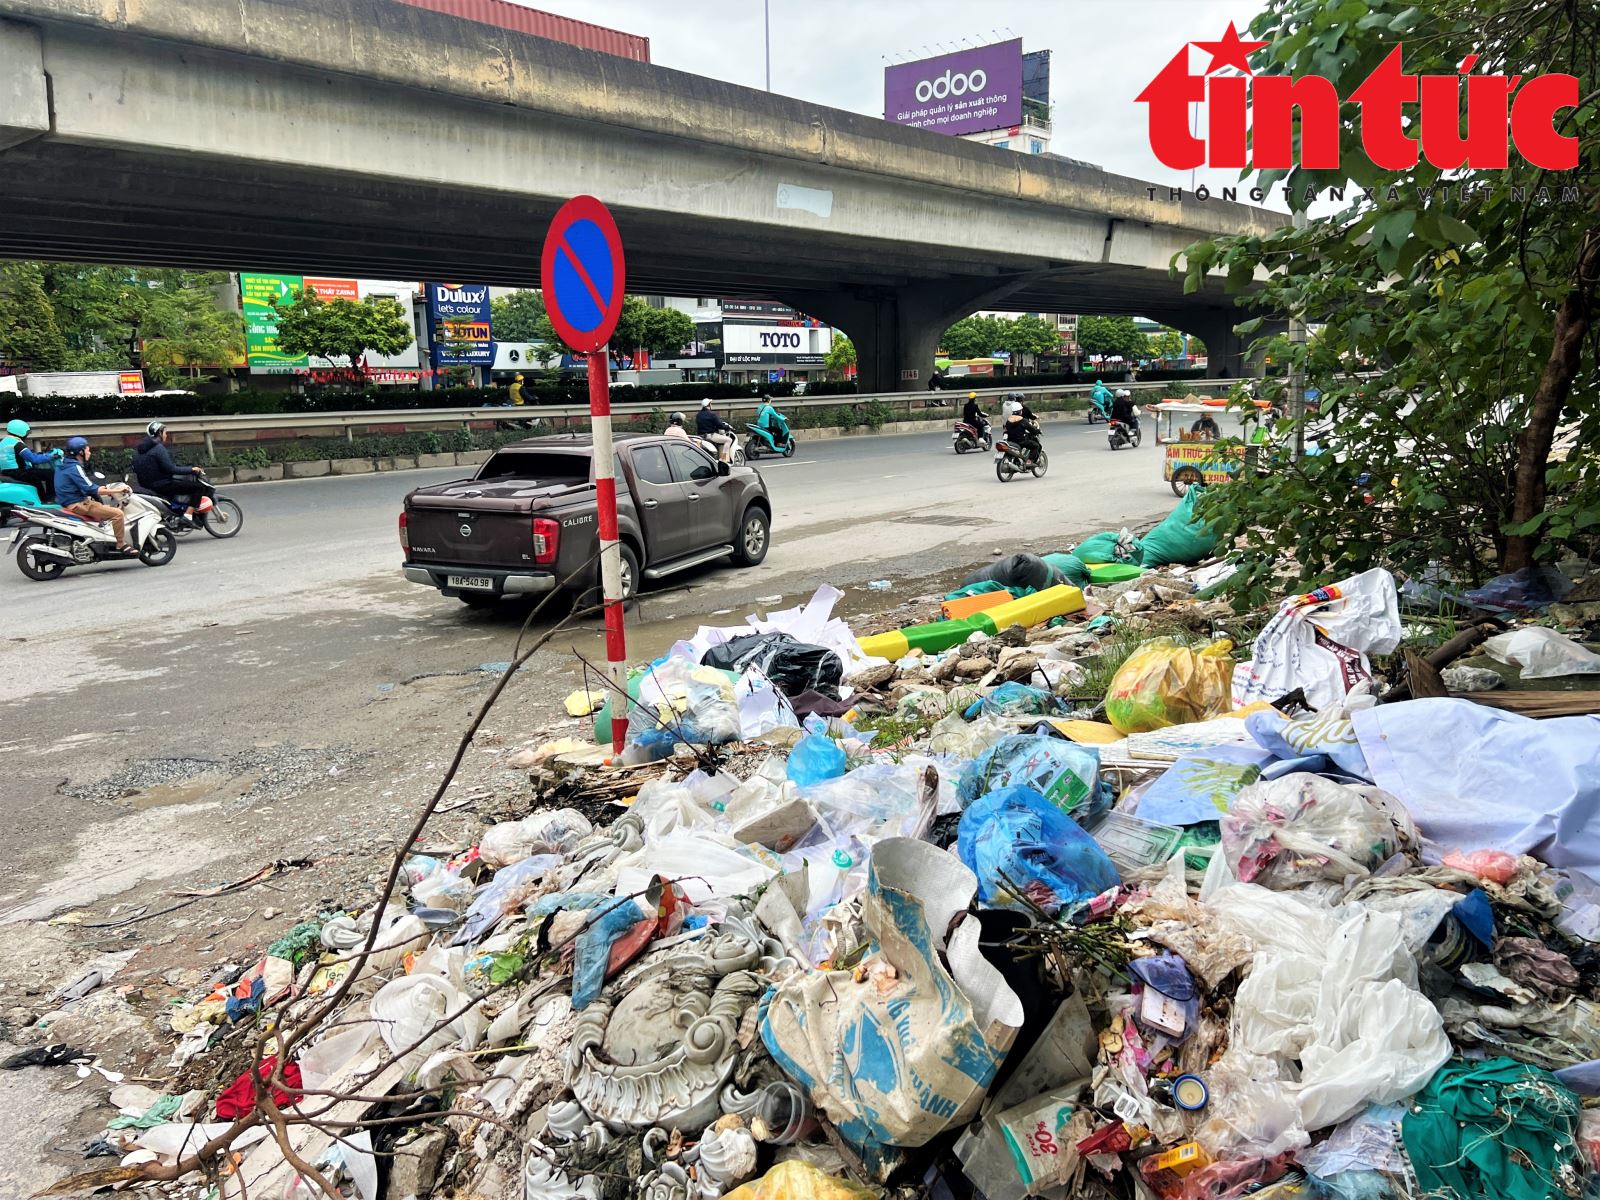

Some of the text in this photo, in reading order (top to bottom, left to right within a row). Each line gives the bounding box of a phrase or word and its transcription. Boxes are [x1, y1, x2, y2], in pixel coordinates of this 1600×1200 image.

[915, 69, 987, 103] odoo
[897, 94, 1007, 120] Giải pháp quản lý sản xuất thông
[923, 117, 935, 126] cho
[937, 114, 949, 124] mọi
[951, 111, 972, 122] doanh
[973, 107, 998, 119] nghiệp
[436, 286, 481, 304] Dulux
[438, 304, 481, 314] let's colour
[760, 332, 801, 348] TOTO
[563, 515, 593, 528] CALIBRE
